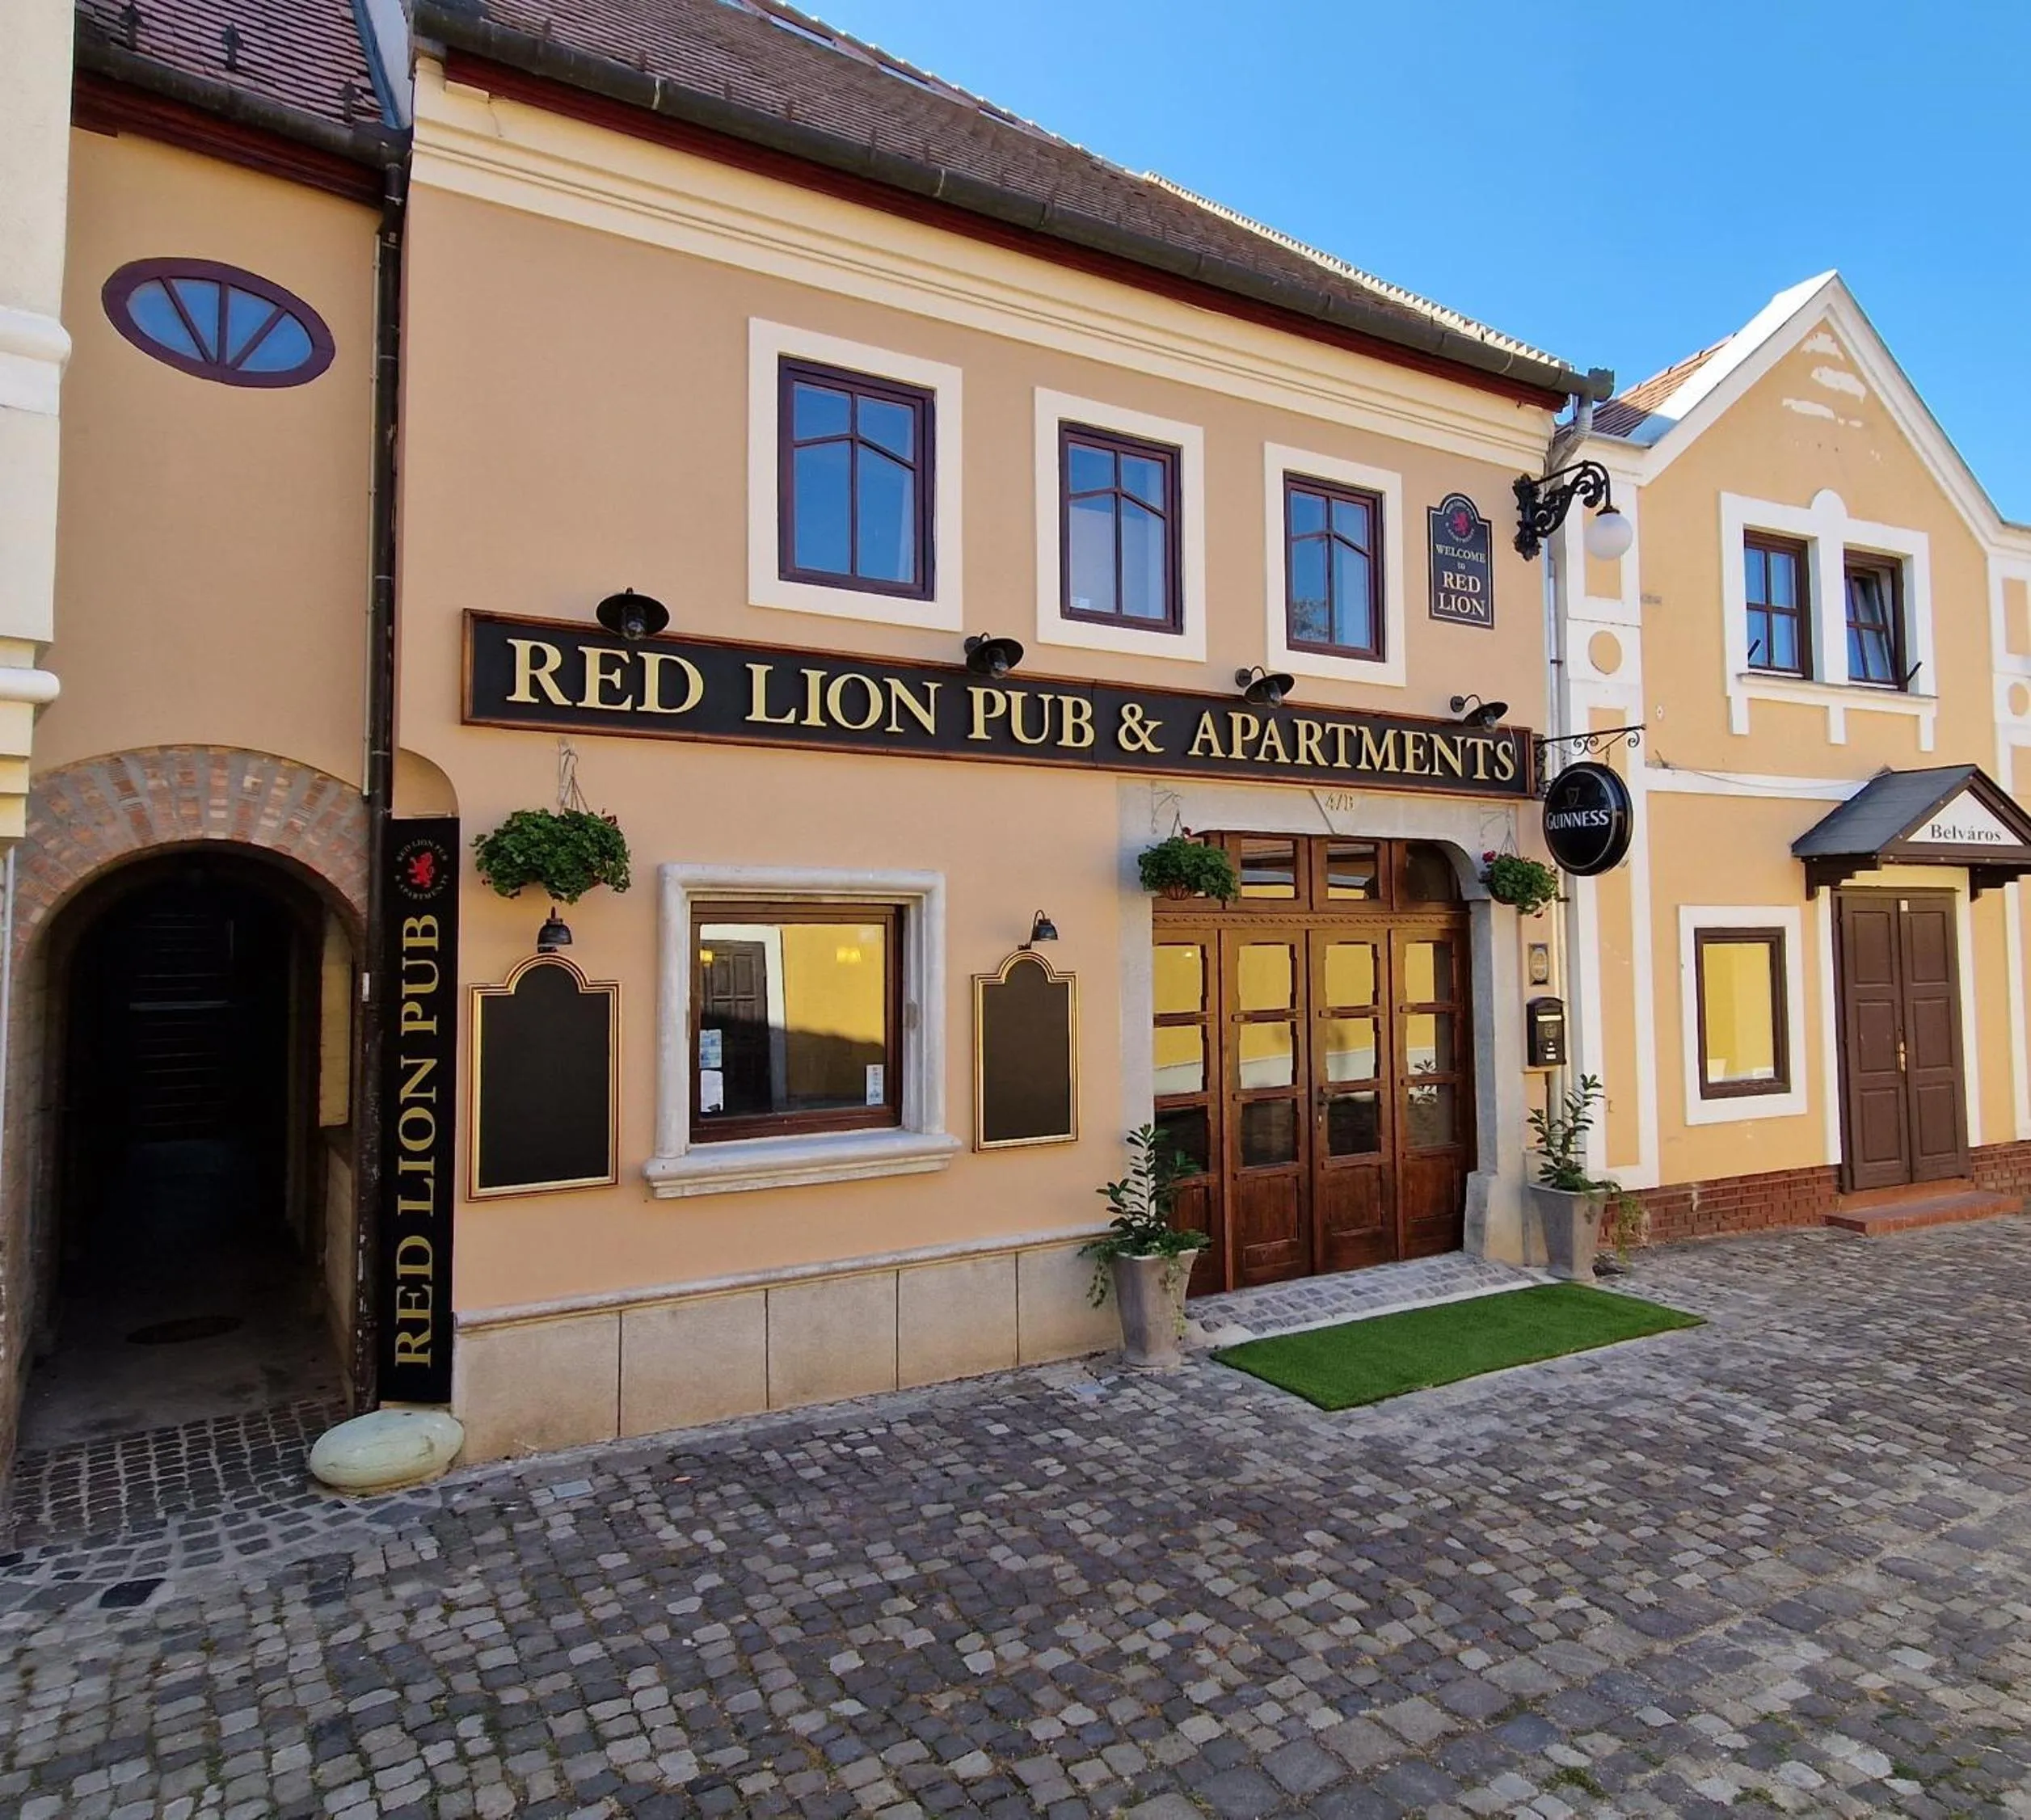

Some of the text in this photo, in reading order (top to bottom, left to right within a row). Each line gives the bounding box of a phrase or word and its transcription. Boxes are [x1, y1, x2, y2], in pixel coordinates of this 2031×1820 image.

[1435, 544, 1485, 563] WELCOME
[1443, 571, 1481, 593] RED
[1439, 592, 1485, 617] LION
[506, 638, 1516, 782] RED LION PUB & APARTMENTS
[1547, 809, 1610, 830] GUINNESS
[1931, 824, 2002, 841] Belváros
[394, 914, 440, 1369] RED LION PUB
